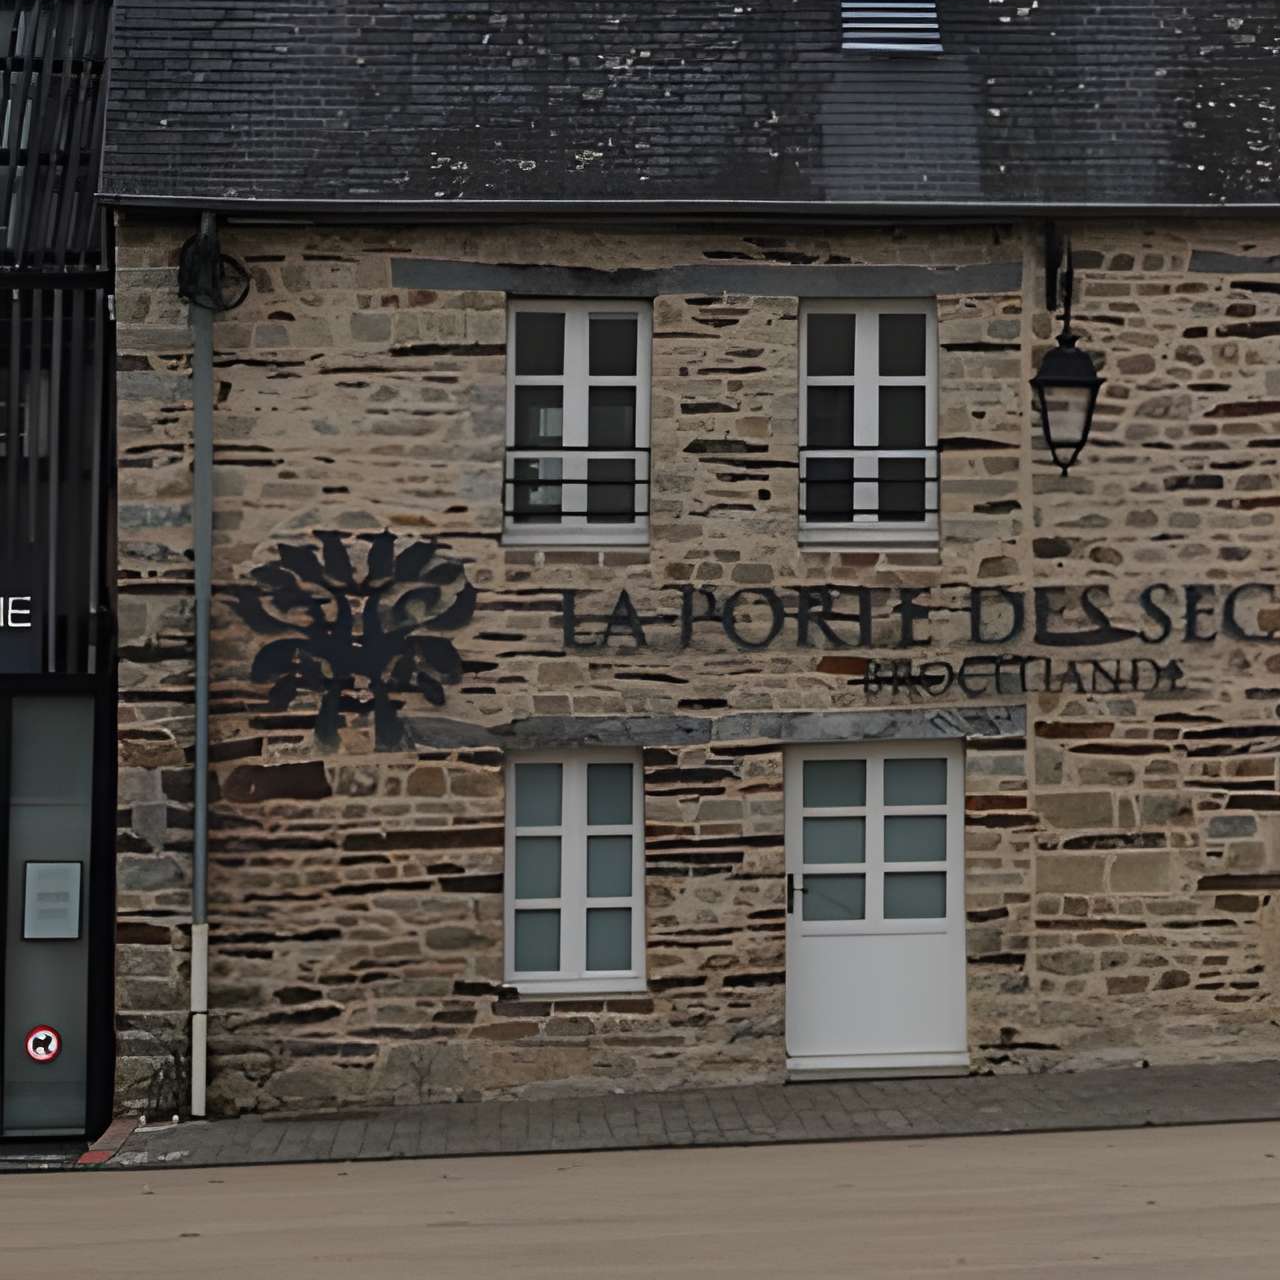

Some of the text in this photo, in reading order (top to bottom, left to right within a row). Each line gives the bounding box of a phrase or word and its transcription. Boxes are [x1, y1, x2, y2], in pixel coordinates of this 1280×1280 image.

[561, 588, 648, 648] LA
[680, 586, 932, 651] PORTE
[968, 584, 1124, 646] DES
